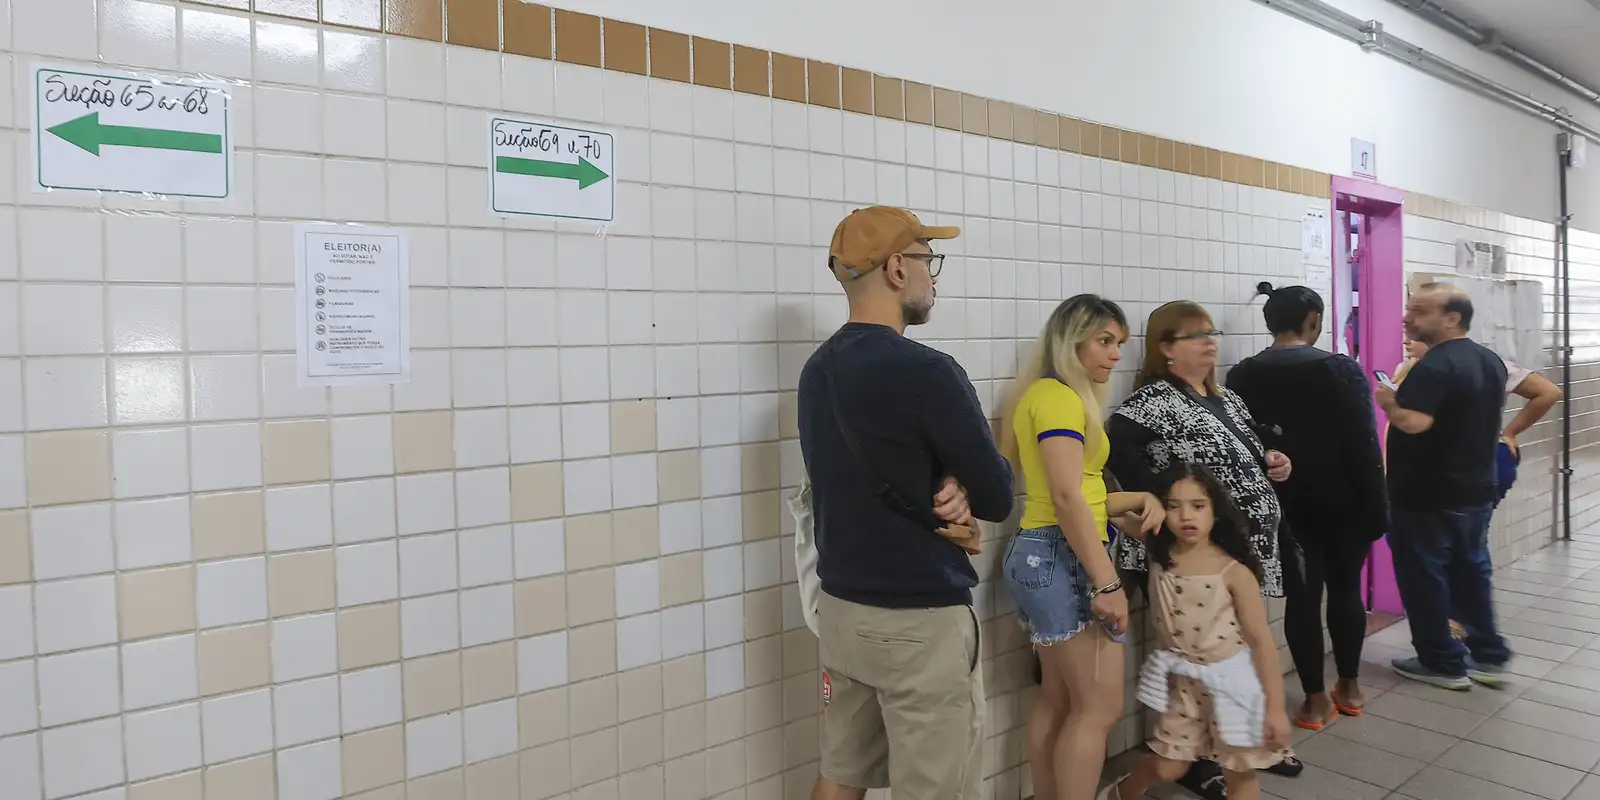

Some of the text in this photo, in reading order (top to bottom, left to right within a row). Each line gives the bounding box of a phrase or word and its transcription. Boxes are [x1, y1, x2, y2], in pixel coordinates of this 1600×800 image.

[46, 74, 115, 109] Seção
[120, 84, 154, 111] 65
[184, 87, 208, 114] 68
[494, 122, 539, 152] Seção
[539, 129, 559, 153] 69
[578, 135, 601, 159] 70
[324, 242, 382, 254] ELEITOR(A)
